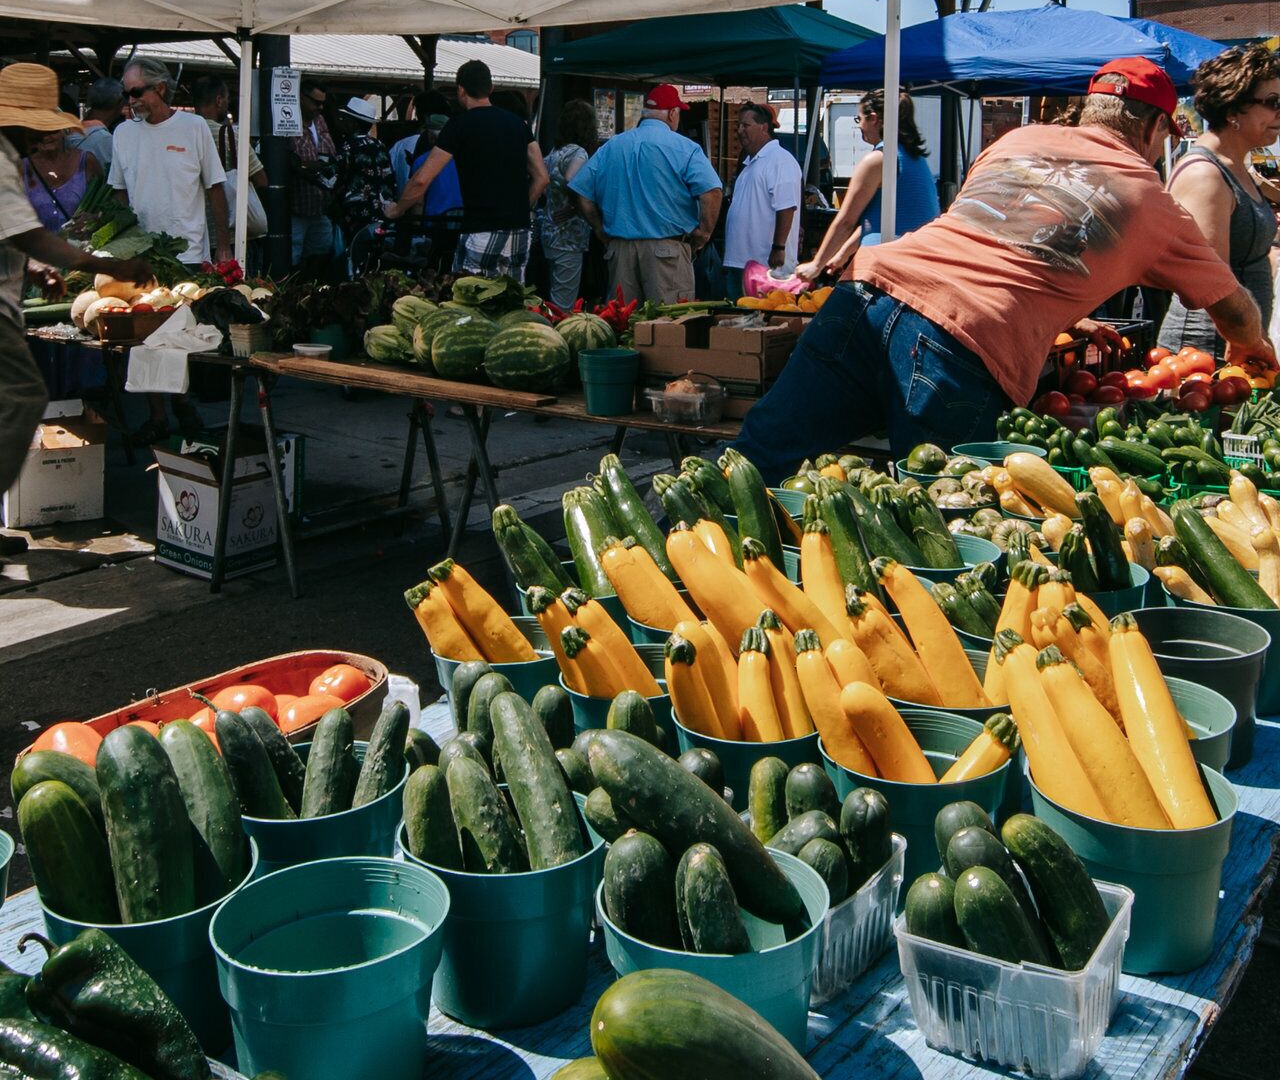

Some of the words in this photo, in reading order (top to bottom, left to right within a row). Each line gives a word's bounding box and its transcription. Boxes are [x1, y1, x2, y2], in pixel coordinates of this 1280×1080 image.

[162, 516, 212, 546] SAKURA
[230, 526, 274, 545] SAKURA
[159, 544, 183, 561] Green
[184, 552, 213, 570] Onions
